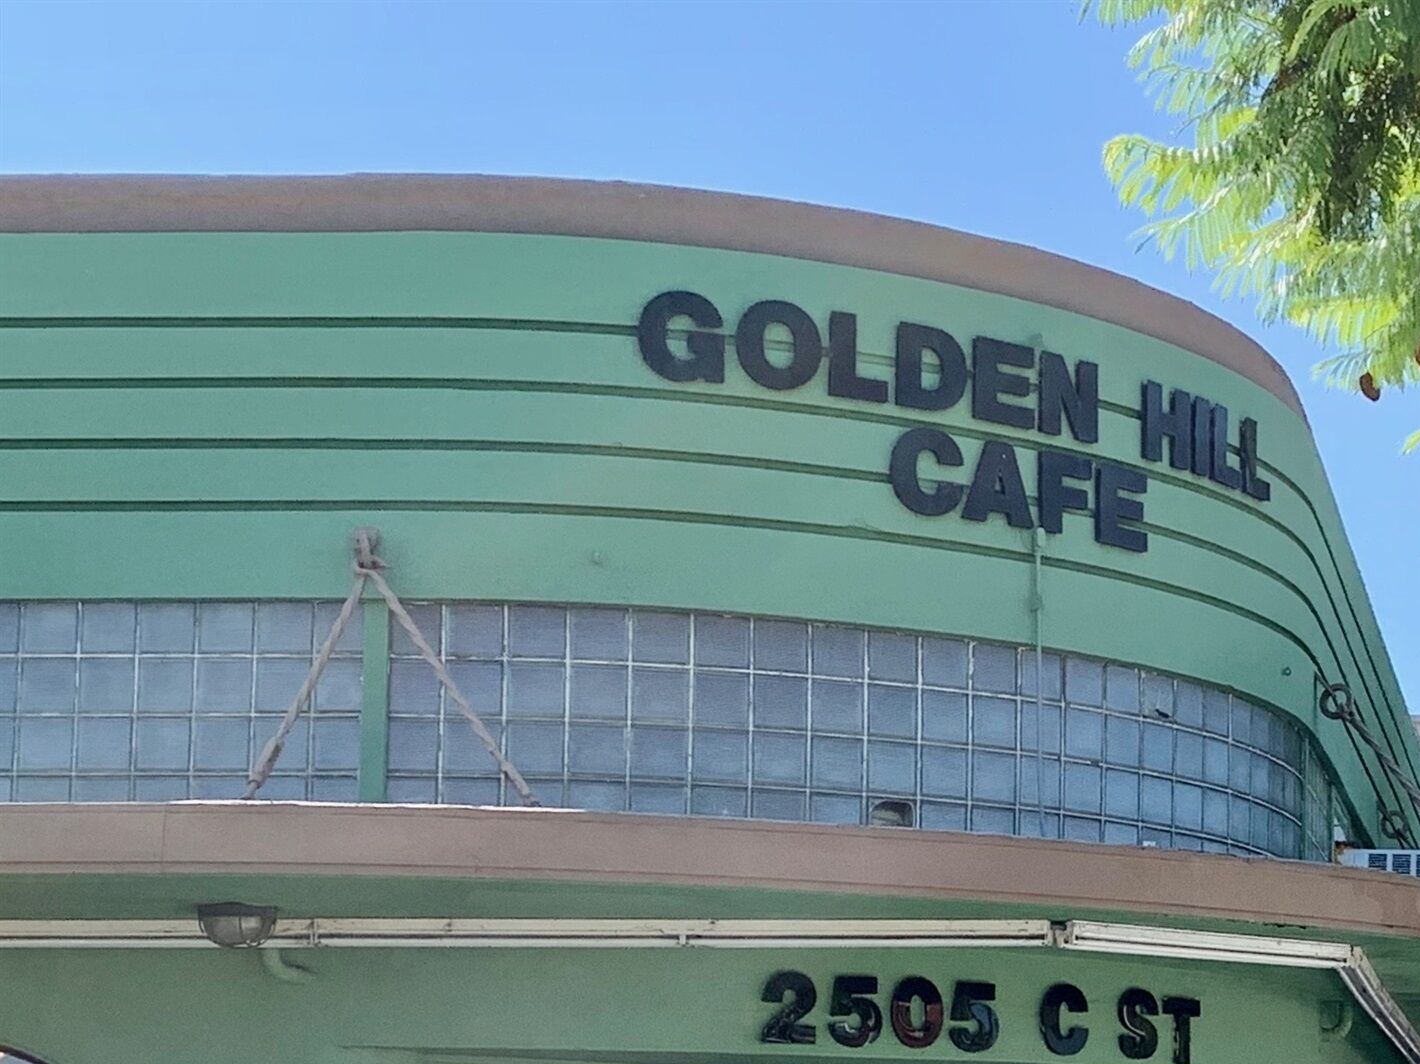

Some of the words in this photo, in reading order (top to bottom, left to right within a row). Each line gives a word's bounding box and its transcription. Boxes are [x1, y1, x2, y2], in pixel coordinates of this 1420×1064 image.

[637, 290, 1098, 443] GOLDEN
[1140, 379, 1271, 502] HILL
[890, 426, 1148, 553] CAFE
[760, 969, 999, 1052] 2505
[1039, 982, 1089, 1056] C
[1116, 986, 1201, 1064] ST
